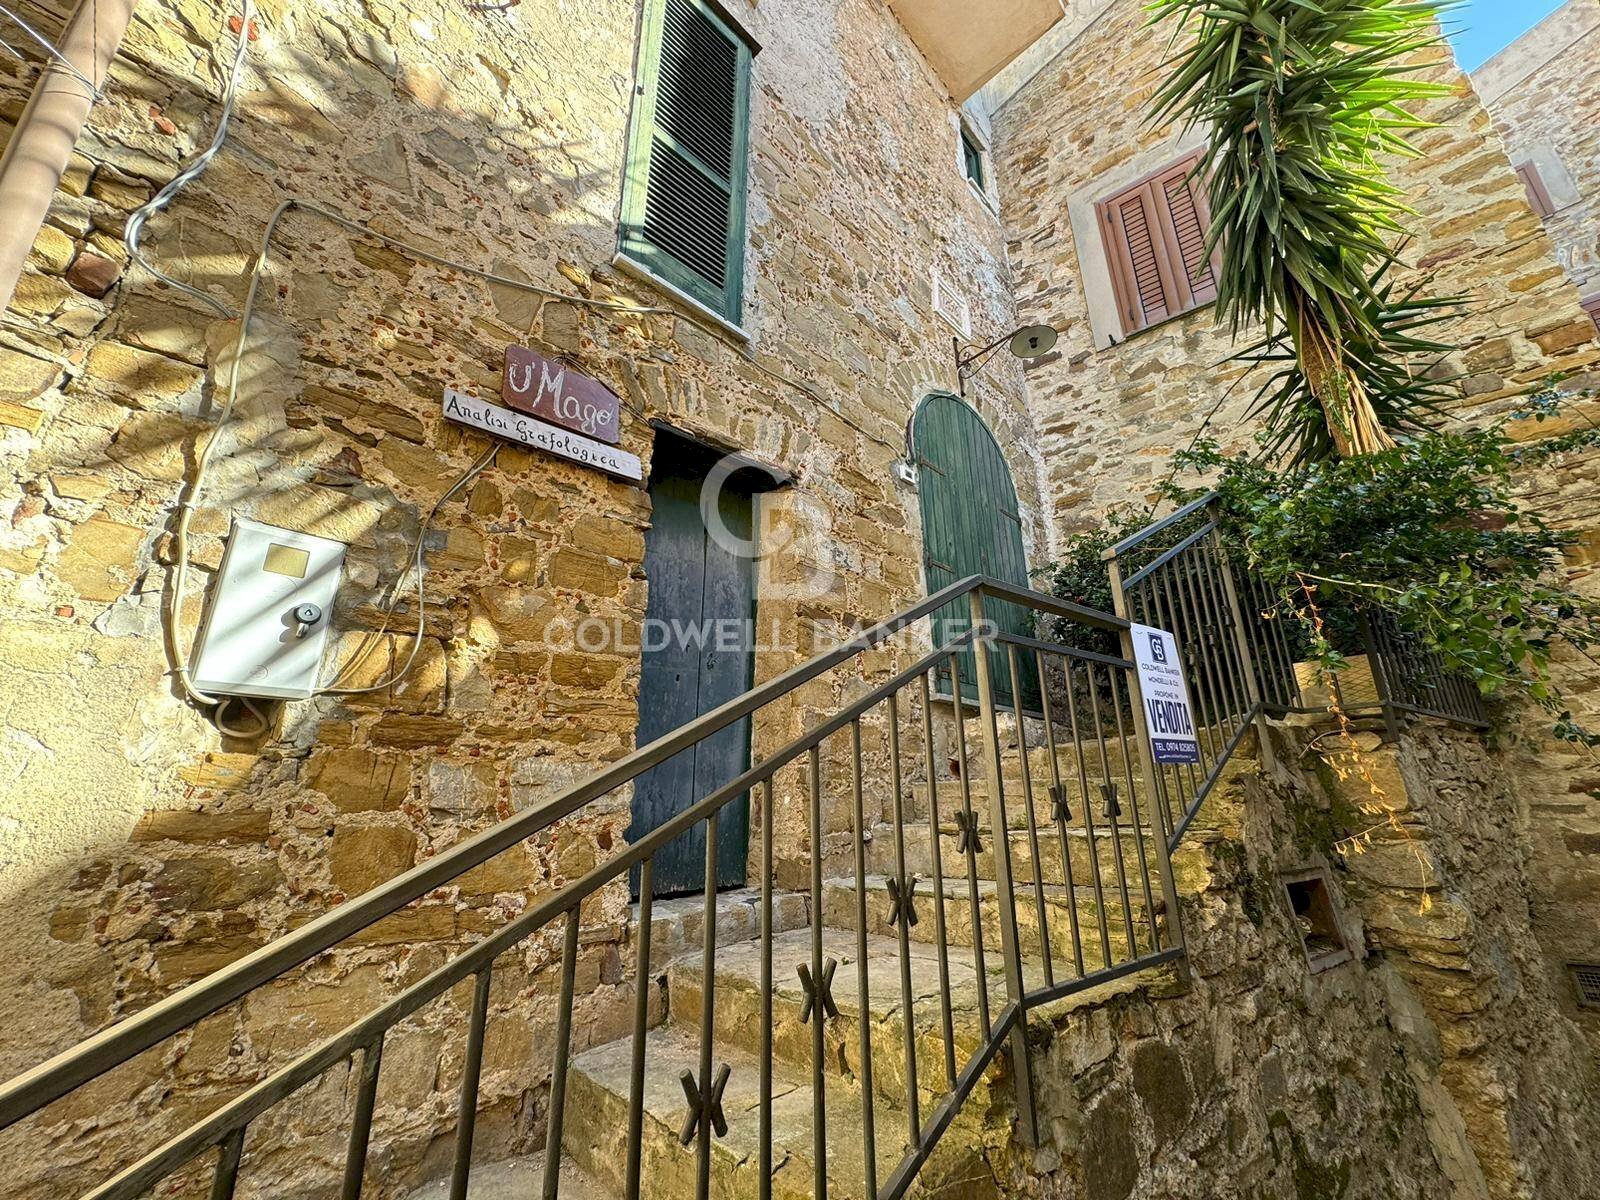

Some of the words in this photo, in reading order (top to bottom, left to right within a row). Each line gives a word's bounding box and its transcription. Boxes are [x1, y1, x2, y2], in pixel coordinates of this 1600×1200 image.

[446, 395, 508, 430] Analisi
[516, 419, 620, 470] Grafologica
[1142, 662, 1164, 673] COLDWELL
[1147, 698, 1193, 735] VENDITA
